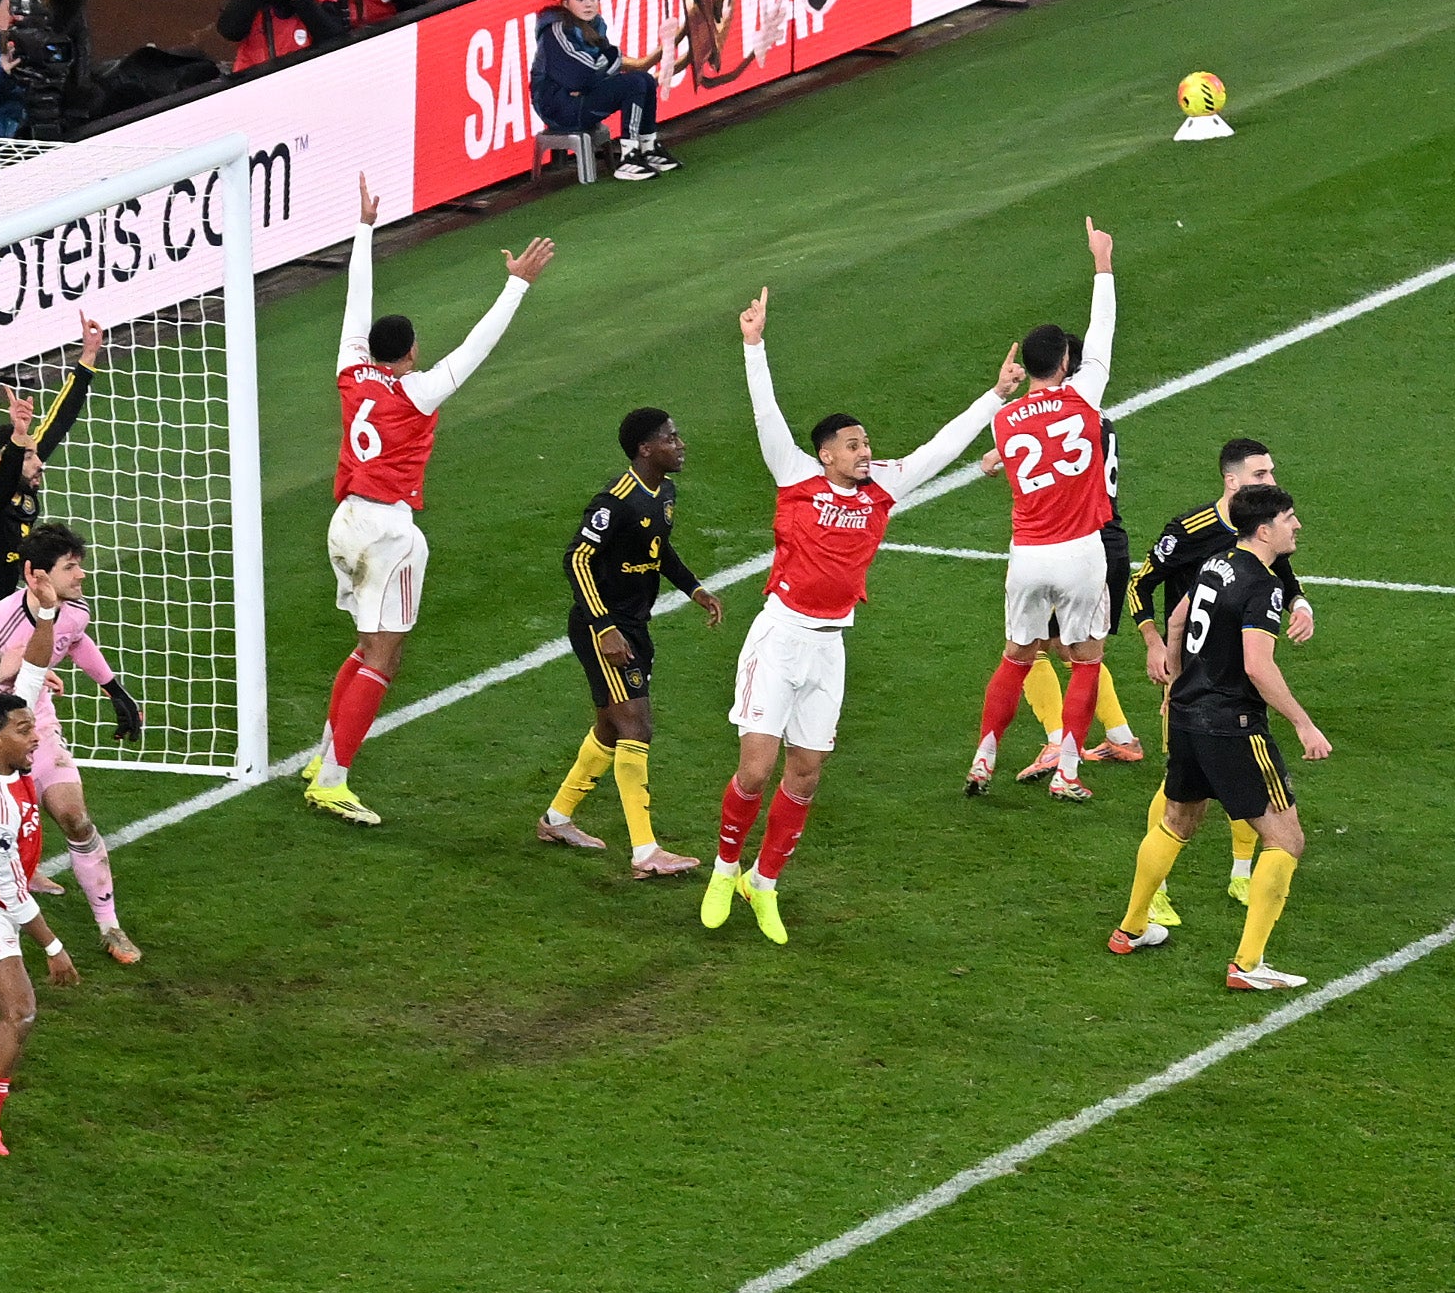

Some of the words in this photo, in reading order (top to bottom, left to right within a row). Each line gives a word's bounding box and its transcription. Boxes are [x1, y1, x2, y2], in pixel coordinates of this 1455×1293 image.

[350, 398, 382, 463] 6
[1006, 398, 1063, 427] MERINO
[1004, 413, 1093, 495] 23
[1186, 583, 1218, 654] 5
